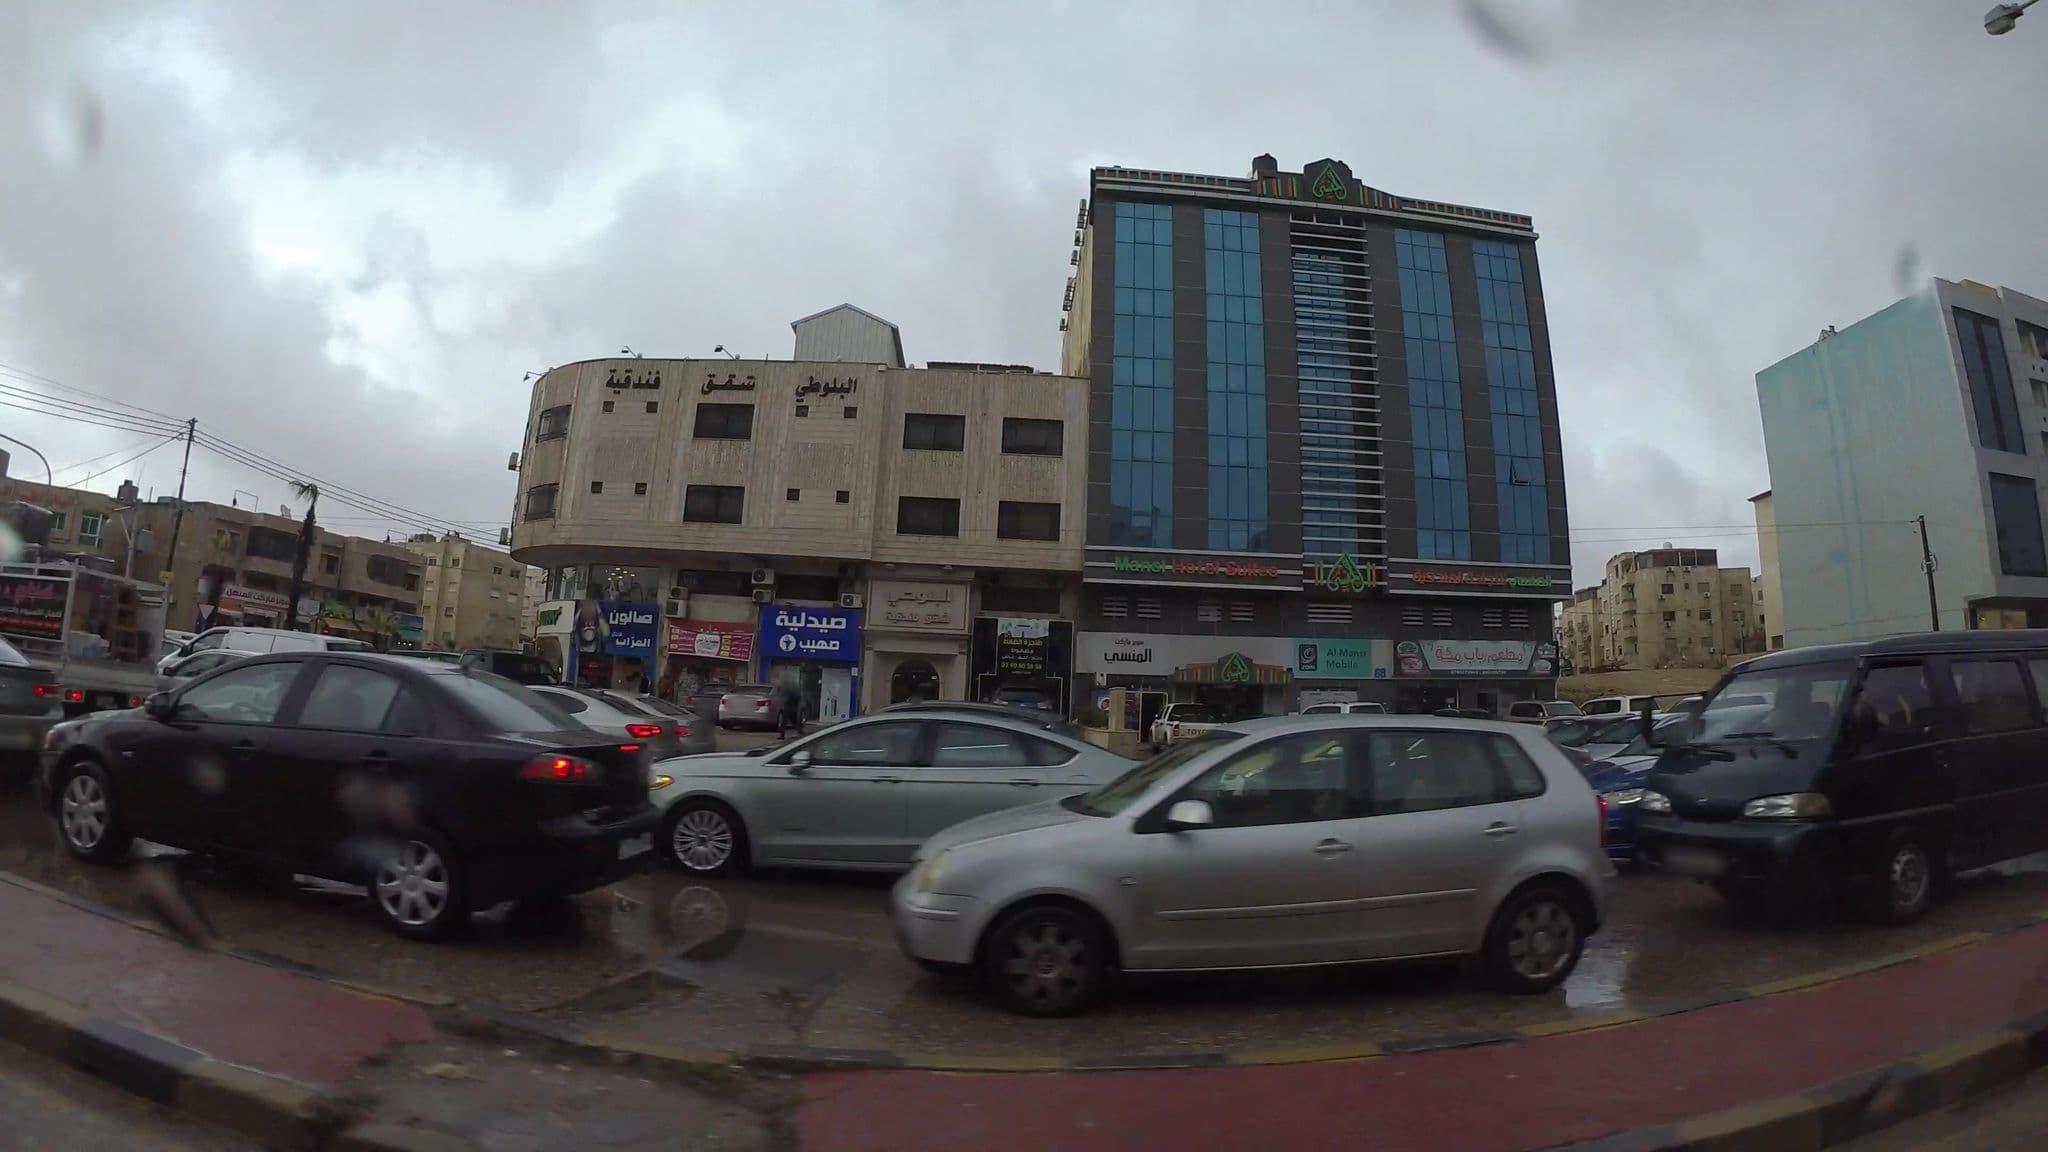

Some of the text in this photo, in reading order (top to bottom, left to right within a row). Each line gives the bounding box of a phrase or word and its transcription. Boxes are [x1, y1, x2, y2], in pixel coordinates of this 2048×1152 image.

[605, 368, 858, 402] البلوطي شقق فندقية
[608, 609, 653, 626] صالون
[775, 610, 847, 633] صيدلية
[799, 640, 840, 653] صهيب
[1326, 648, 1337, 657] Al
[1104, 648, 1152, 665] المنسي
[1464, 647, 1484, 664] باب
[1487, 648, 1523, 663] مطعم
